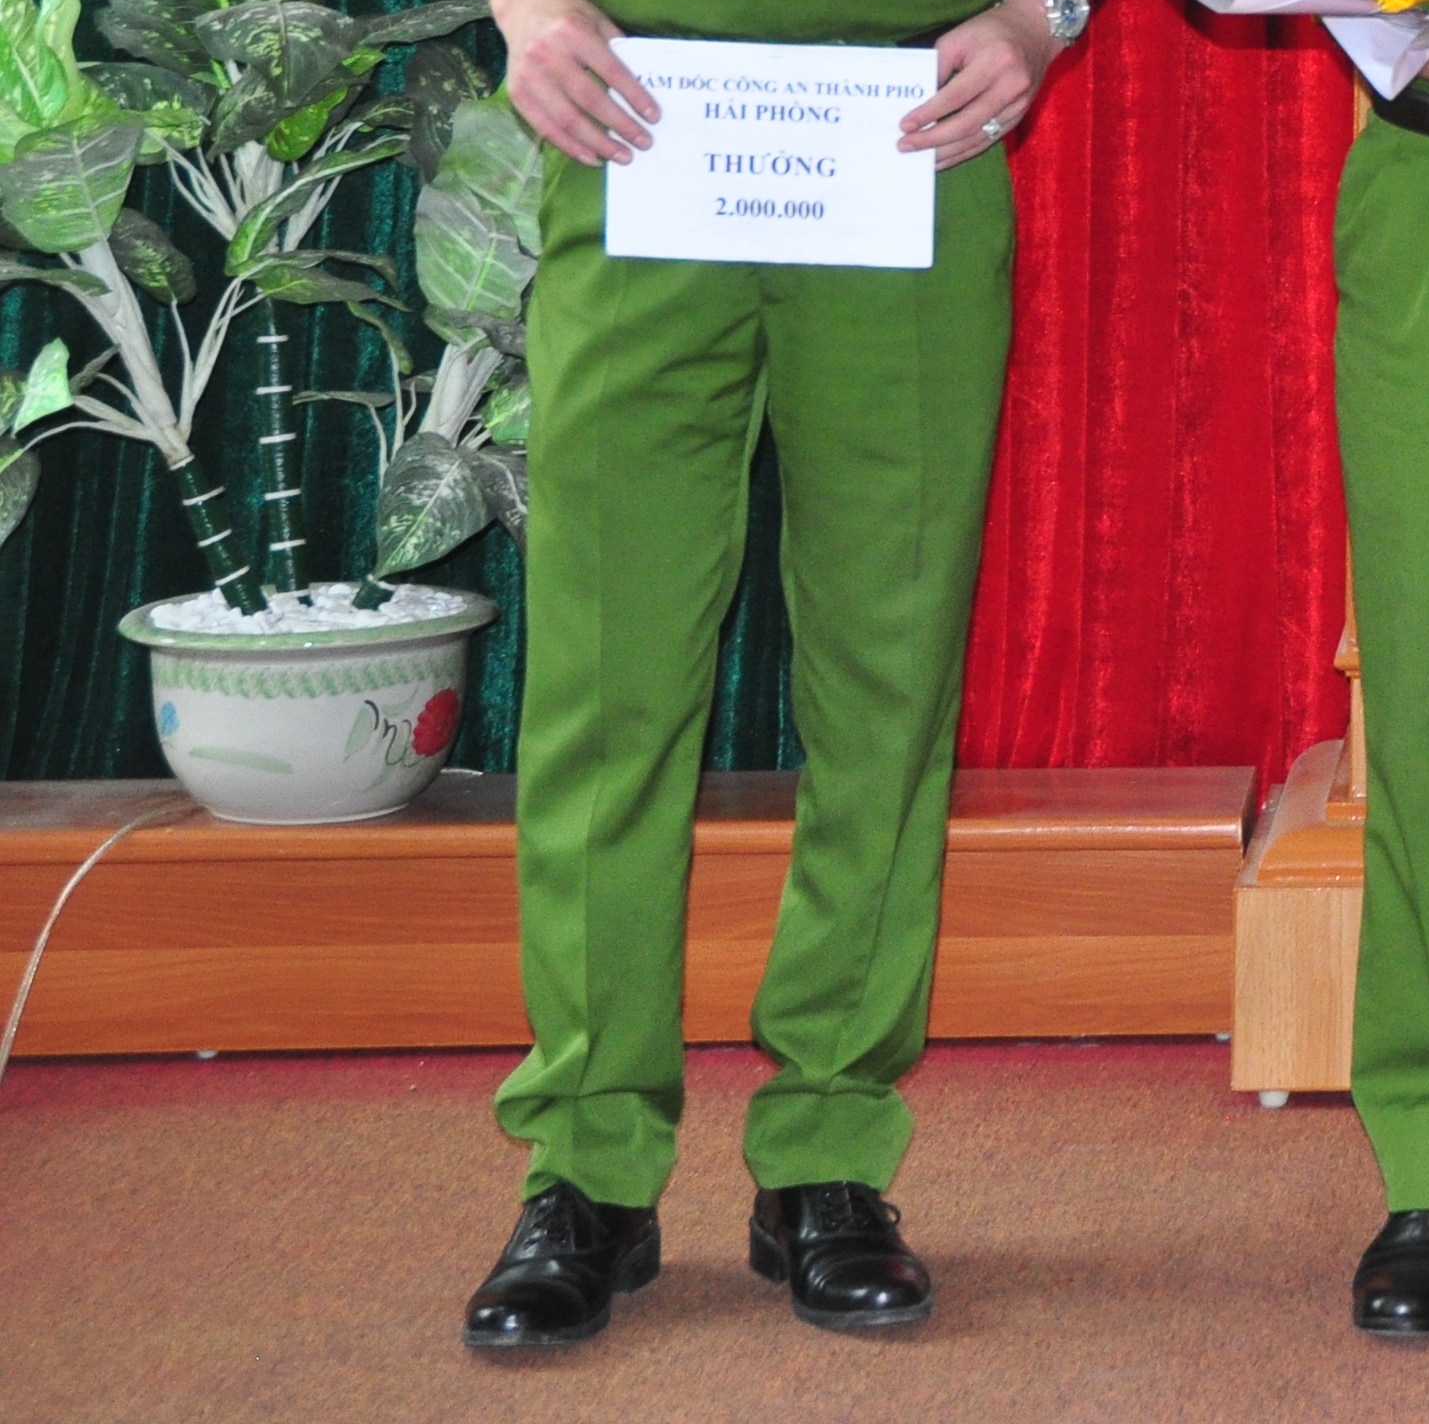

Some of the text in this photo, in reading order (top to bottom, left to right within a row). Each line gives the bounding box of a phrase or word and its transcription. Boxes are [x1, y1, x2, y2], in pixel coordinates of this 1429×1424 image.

[636, 72, 673, 89] ÁM
[723, 75, 777, 93] CÔNG
[784, 81, 808, 94] AN
[814, 79, 880, 97] THÀNH
[704, 98, 841, 124] HẢI PHÒNG
[704, 150, 837, 177] THƯỞNG
[715, 197, 825, 220] 2.000.000
